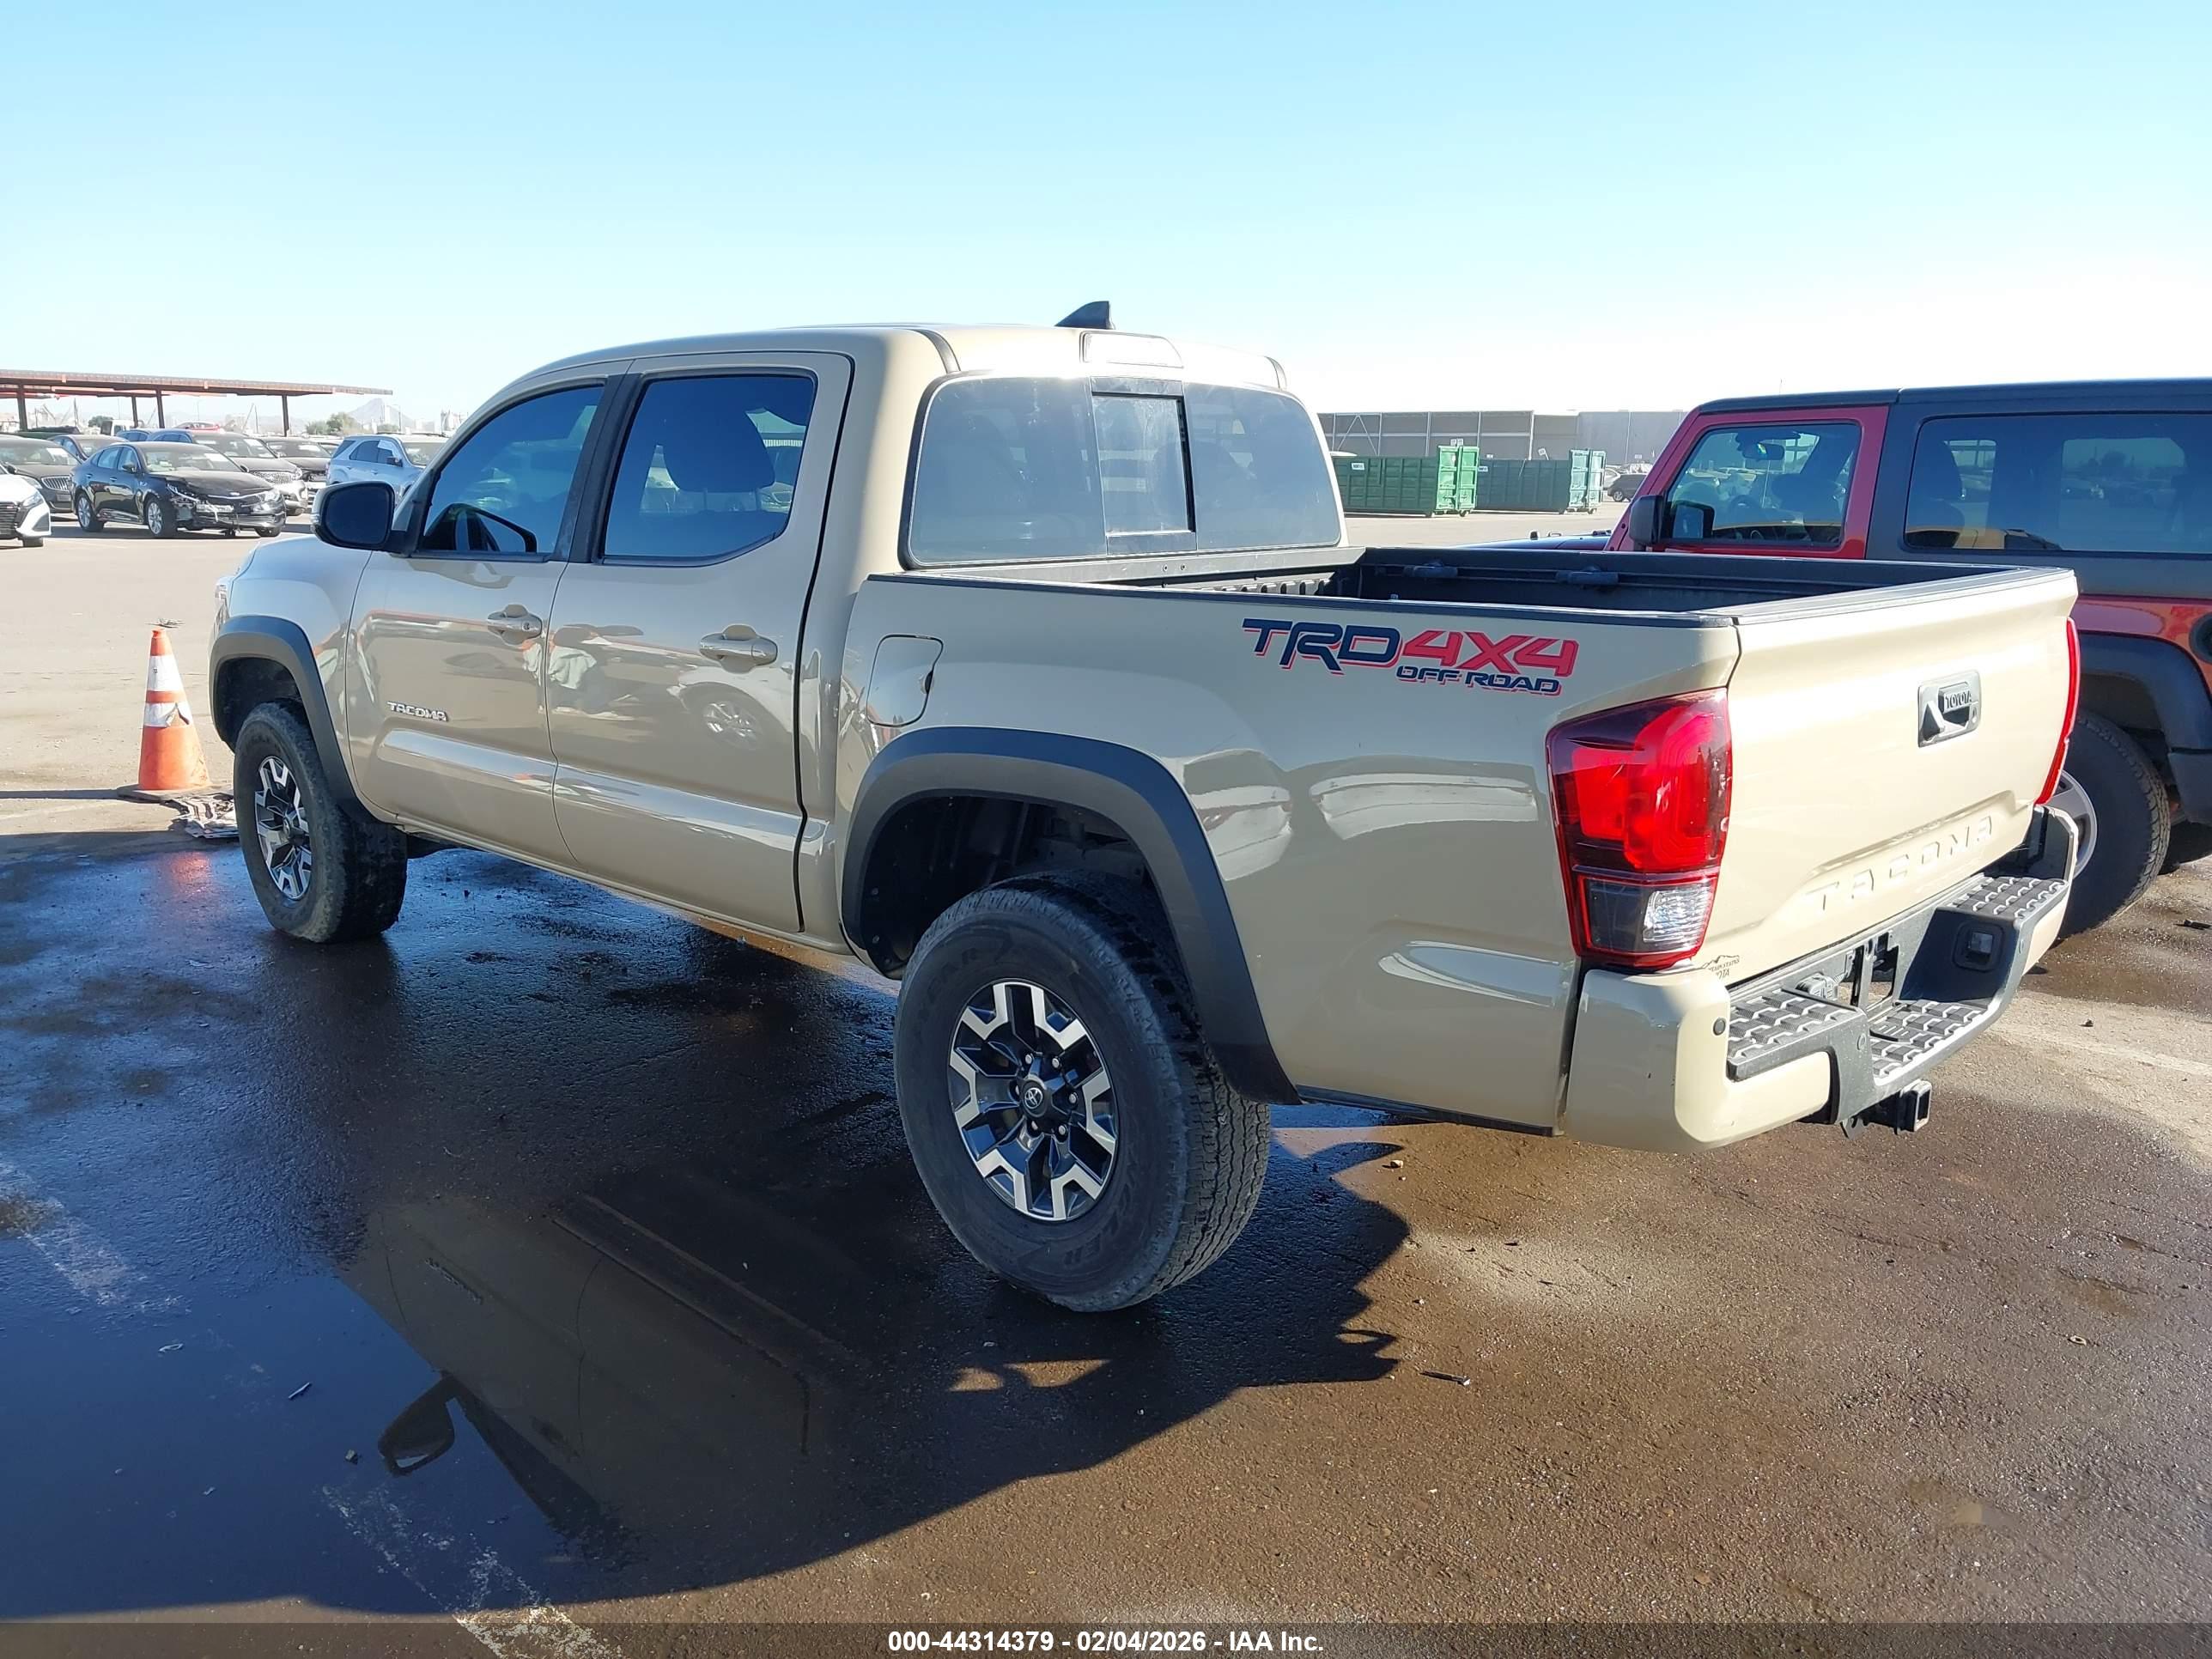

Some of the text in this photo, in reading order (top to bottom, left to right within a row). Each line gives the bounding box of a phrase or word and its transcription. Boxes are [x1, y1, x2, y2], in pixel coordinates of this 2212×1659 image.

[1242, 617, 1580, 678] TRD 4X4
[1395, 665, 1562, 697] OFF ROAD
[386, 701, 448, 722] TACOMA
[1944, 690, 1972, 709] TOYOTA
[1804, 815, 1993, 912] TACOMA
